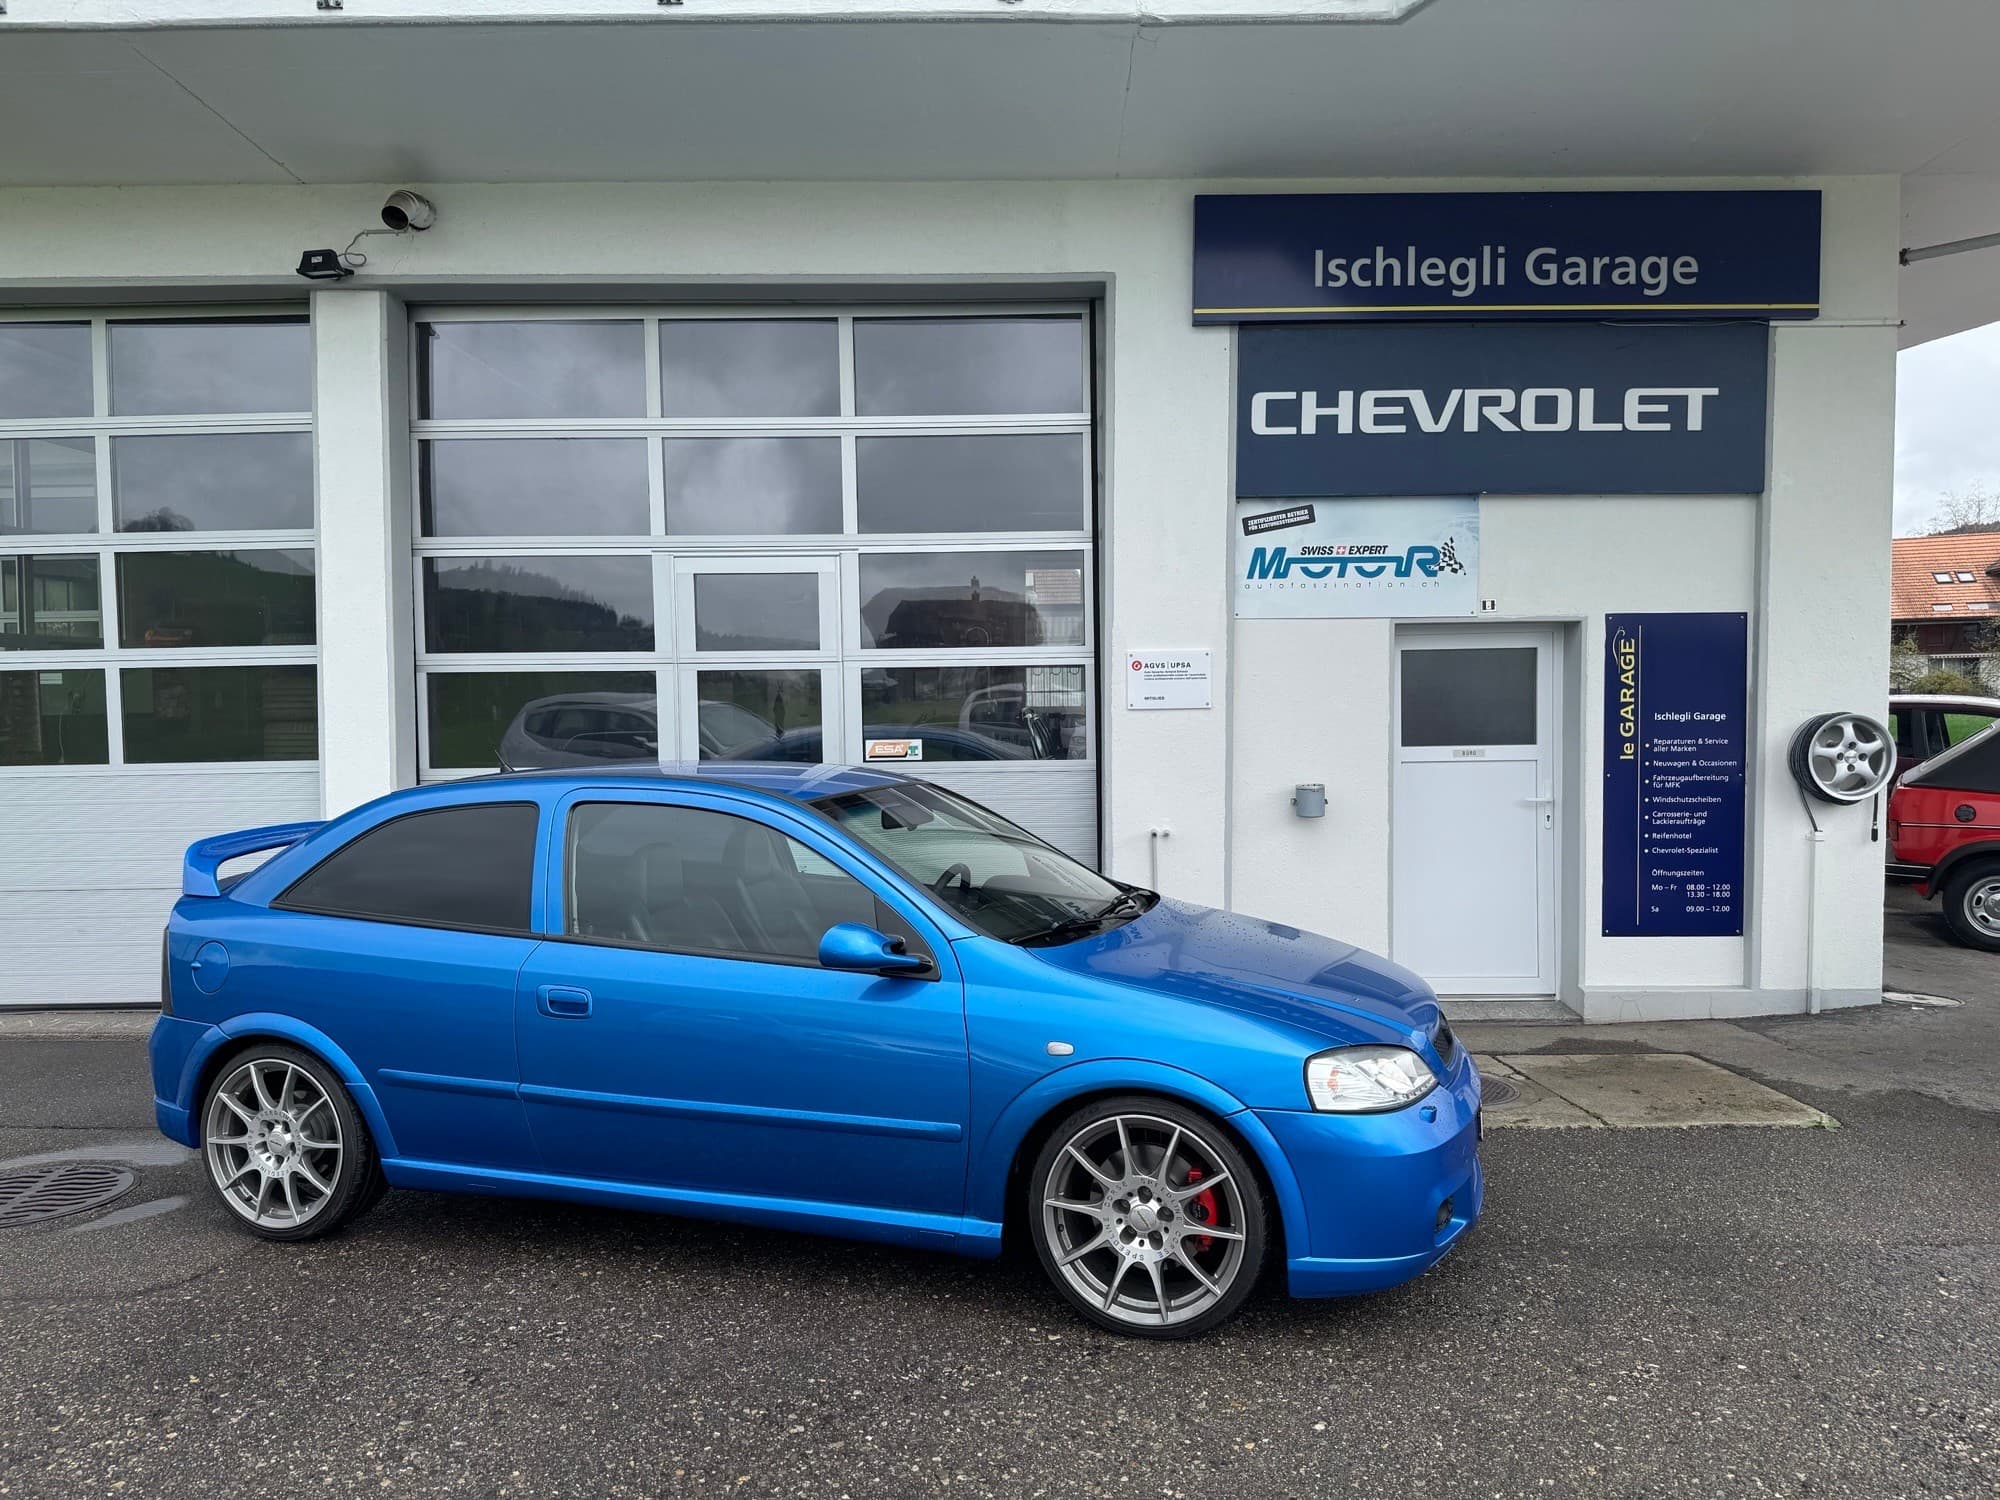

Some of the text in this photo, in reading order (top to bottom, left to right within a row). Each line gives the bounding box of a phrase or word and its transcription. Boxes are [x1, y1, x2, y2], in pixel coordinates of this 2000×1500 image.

[1314, 245, 1699, 296] Ischlegli Garage
[1251, 387, 1719, 435] CHEVROLET
[1248, 514, 1287, 525] ZERTIFIZIERTER
[1301, 545, 1388, 555] SWISS EXPERT
[1244, 581, 1440, 589] autofaszinationch
[1620, 639, 1635, 760] le GARAGE
[1654, 712, 1726, 722] Ischlegli Garage
[1652, 847, 1719, 855] Chevrolet-Spezialist
[1652, 869, 1704, 877] Öffnungszeiten
